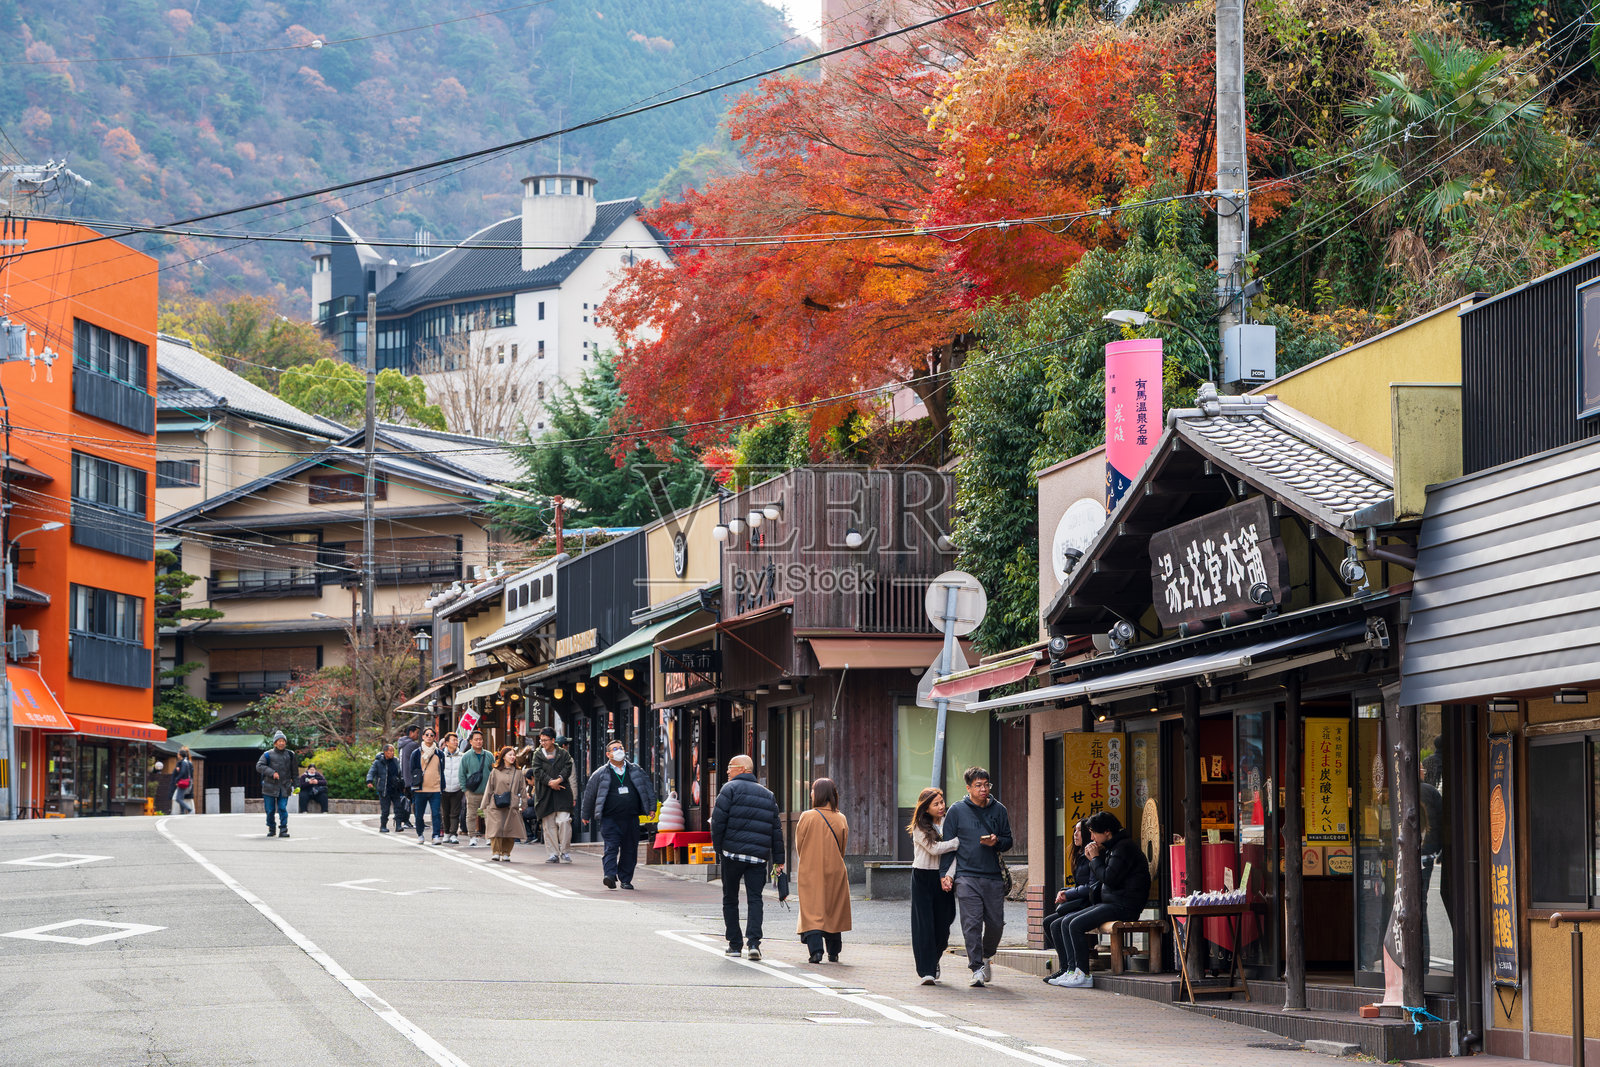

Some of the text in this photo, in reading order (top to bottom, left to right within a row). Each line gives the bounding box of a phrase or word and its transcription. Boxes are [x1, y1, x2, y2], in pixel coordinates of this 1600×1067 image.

[1135, 378, 1148, 447] 有馬温泉名産
[1109, 738, 1120, 808] 賞味期限5秒
[1319, 726, 1333, 833] 元祖なま炭酸せんべい
[1335, 727, 1343, 777] 賞味期限5秒
[1071, 790, 1085, 829] せん
